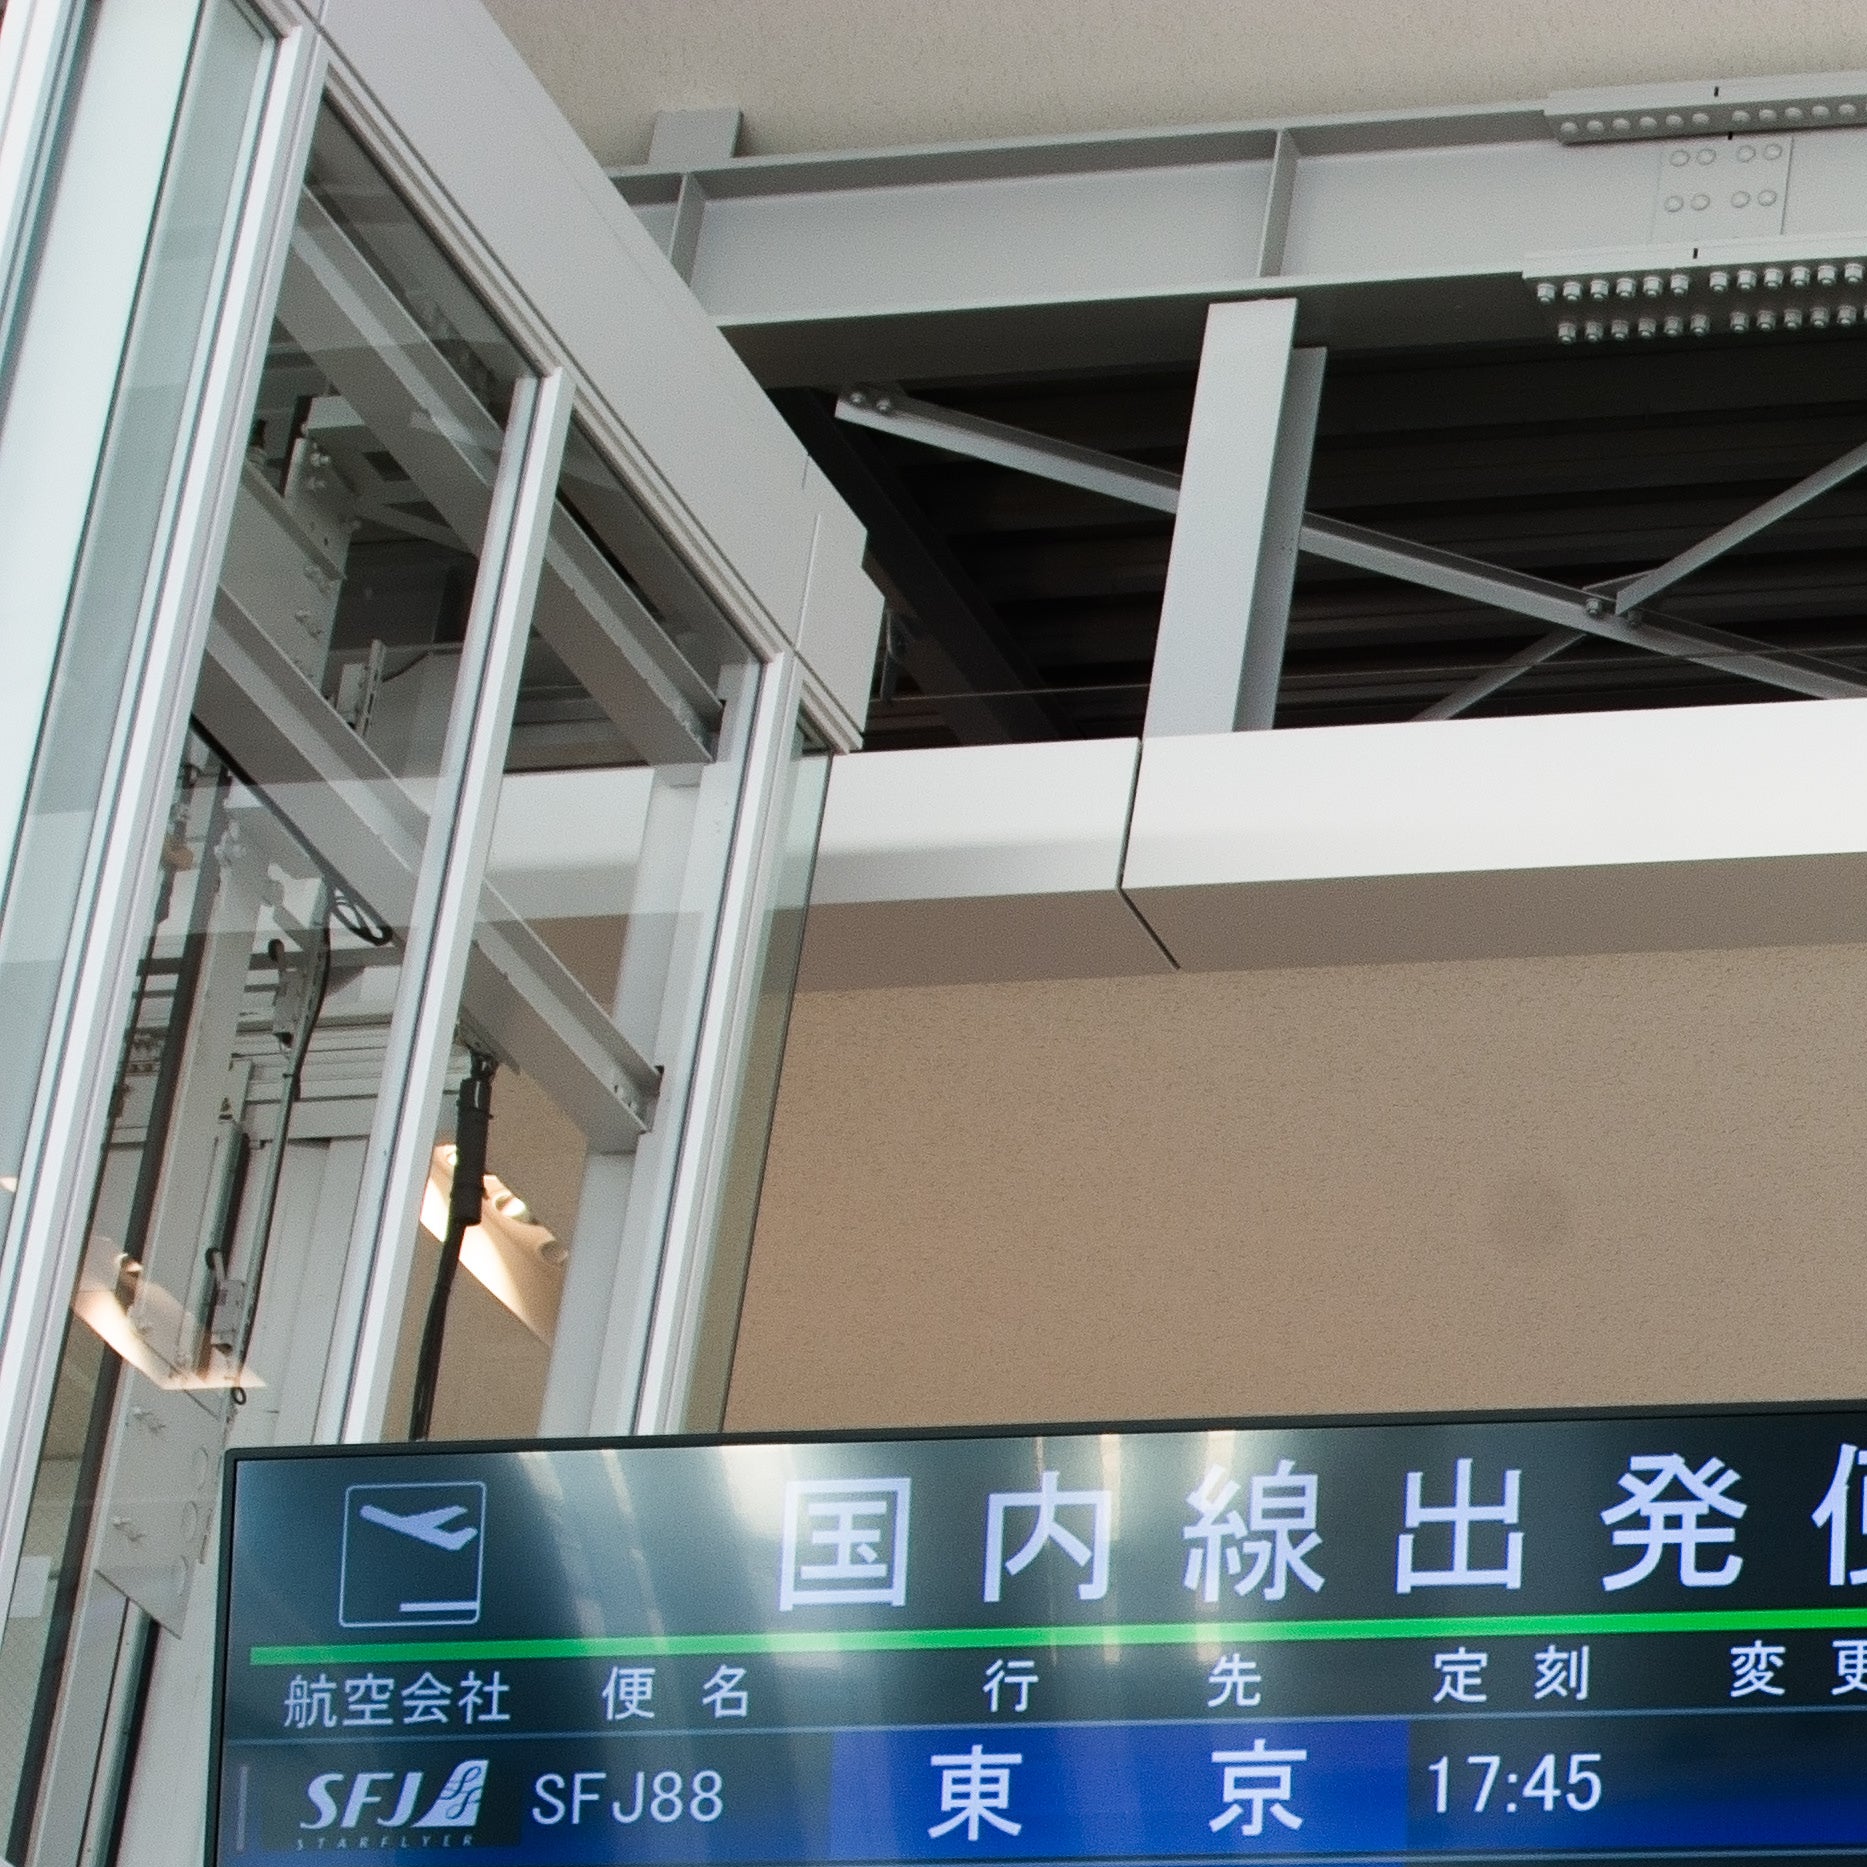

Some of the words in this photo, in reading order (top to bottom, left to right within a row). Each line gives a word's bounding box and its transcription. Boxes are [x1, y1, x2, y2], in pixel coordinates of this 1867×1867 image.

[284, 1670, 511, 1729] 航空会社
[601, 1664, 749, 1721] 便名
[982, 1653, 1263, 1714] 行先
[1433, 1644, 1590, 1703] 定刻
[300, 1771, 423, 1829] SFJ
[532, 1770, 723, 1825] SFJ88
[928, 1738, 1307, 1841] 東京
[1429, 1753, 1602, 1813] 17:45
[296, 1834, 473, 1850] STARFLYER
